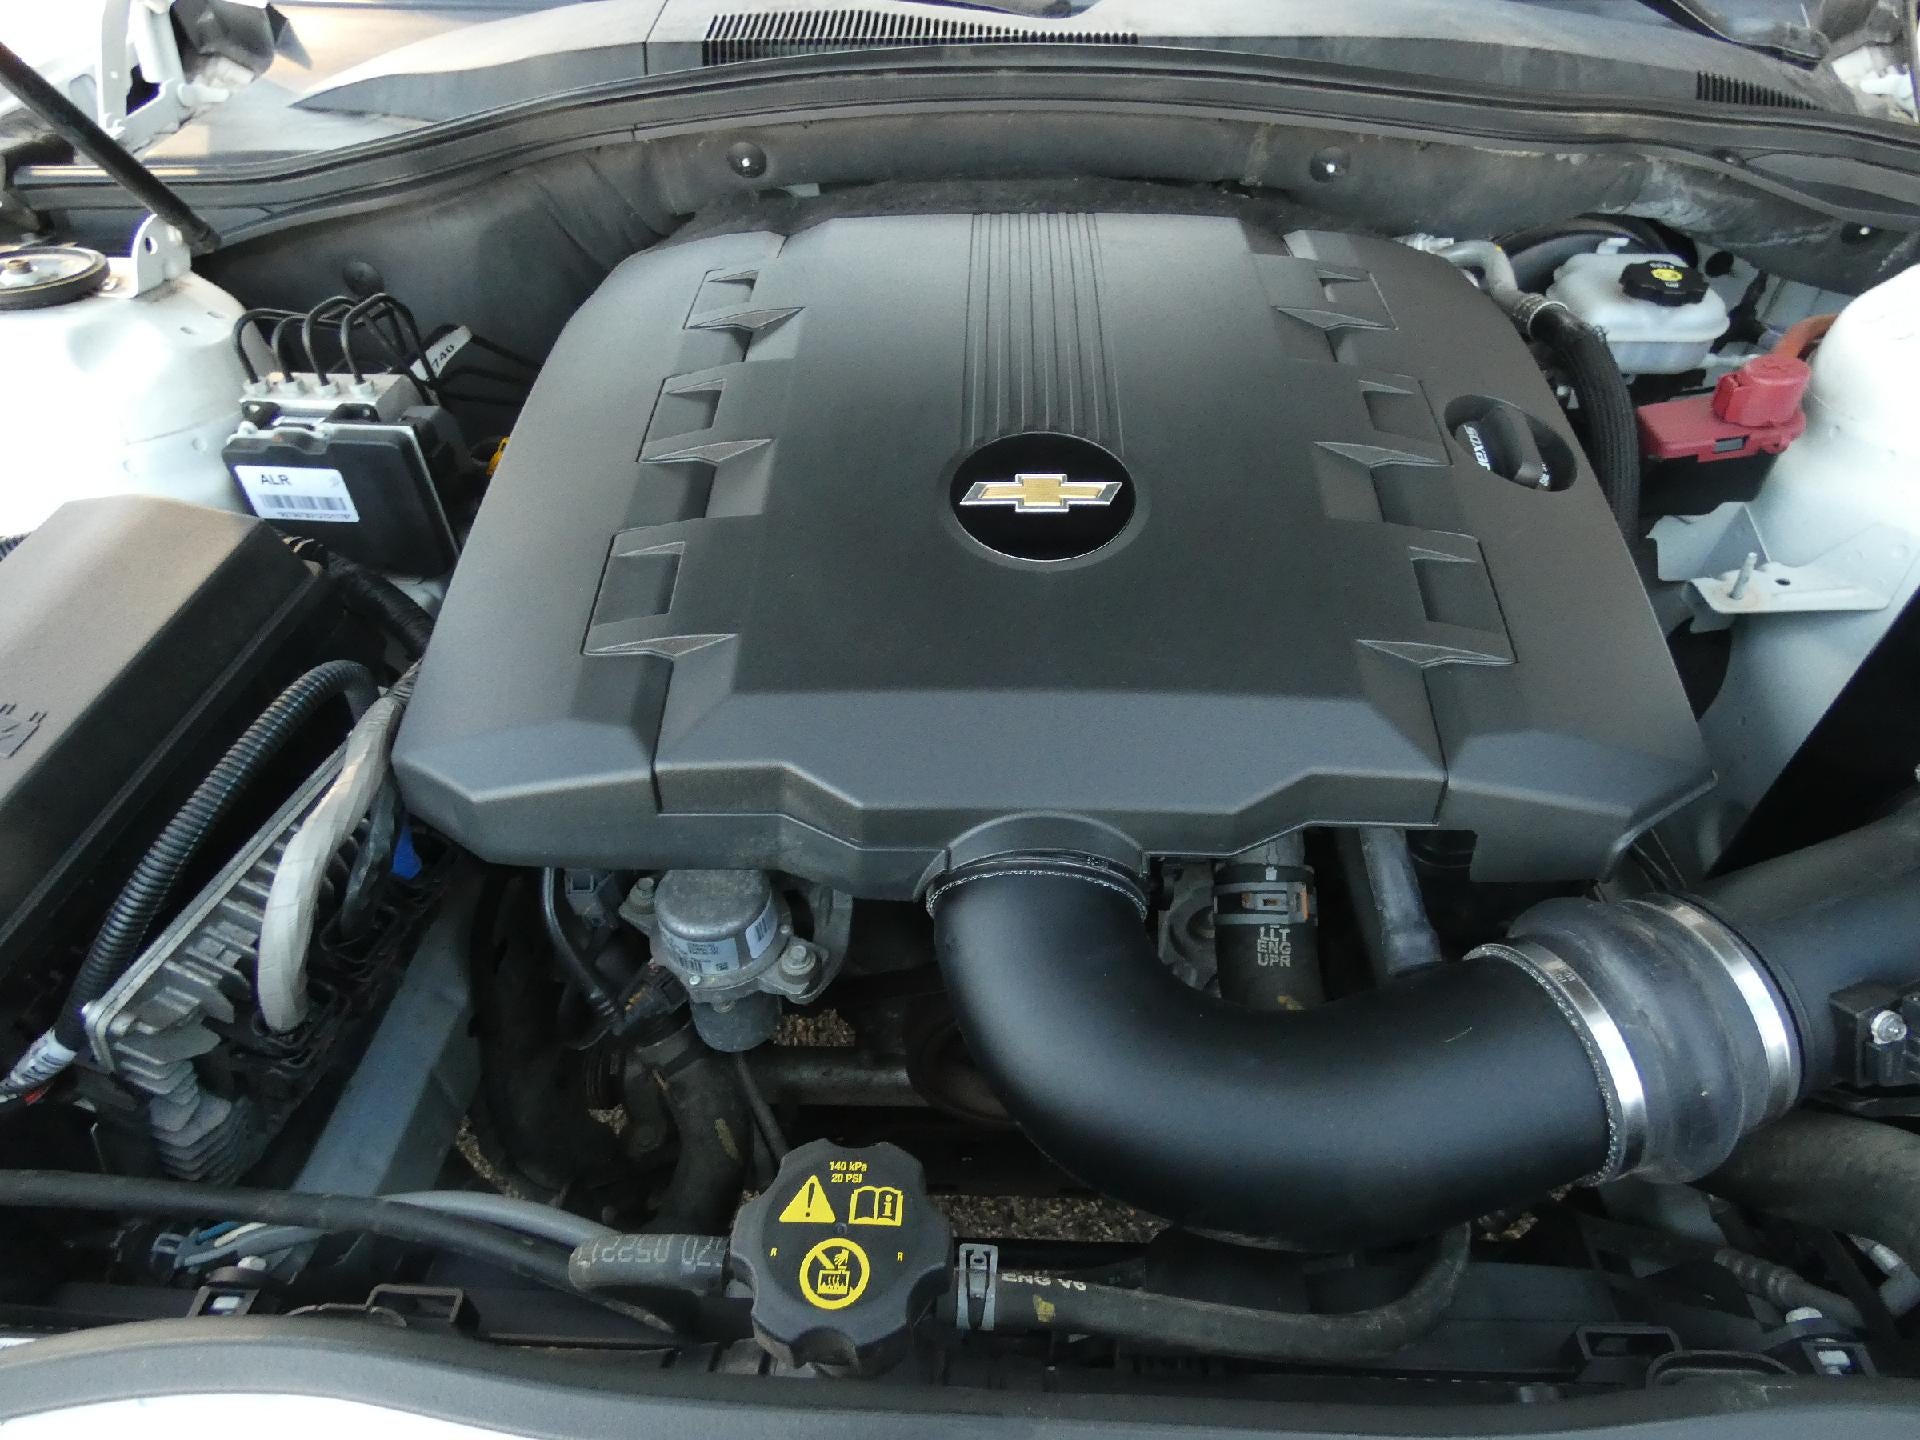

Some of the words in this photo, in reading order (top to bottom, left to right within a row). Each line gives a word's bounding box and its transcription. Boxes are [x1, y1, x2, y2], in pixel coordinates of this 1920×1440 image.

[261, 473, 292, 486] ALR
[1257, 939, 1292, 955] ENG
[1257, 953, 1291, 968] UPR
[829, 1161, 847, 1171] 140
[848, 1161, 868, 1172] kPa
[830, 1173, 844, 1183] 20
[845, 1173, 863, 1183] PSI
